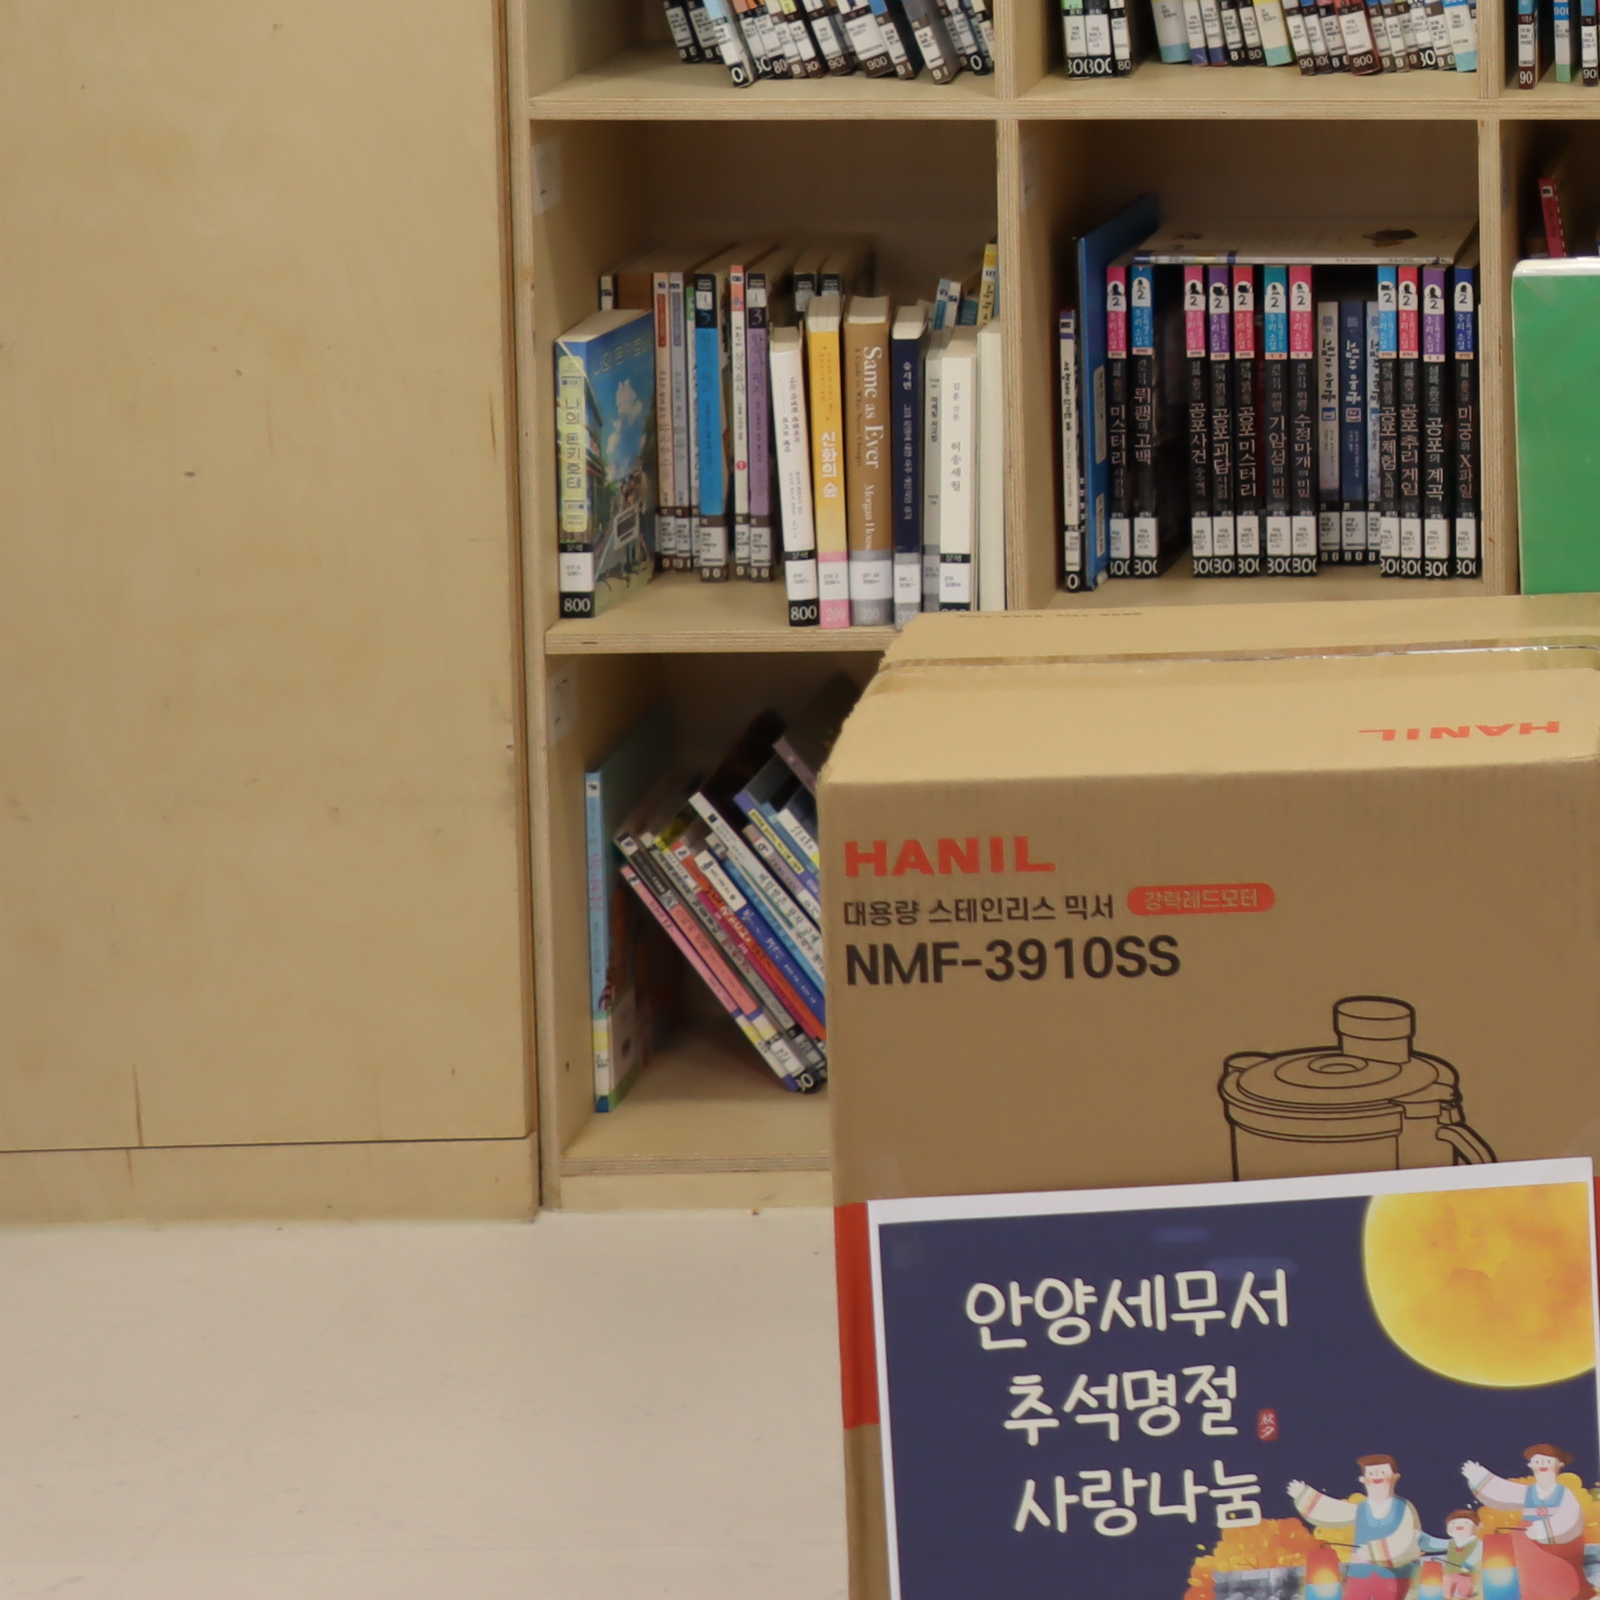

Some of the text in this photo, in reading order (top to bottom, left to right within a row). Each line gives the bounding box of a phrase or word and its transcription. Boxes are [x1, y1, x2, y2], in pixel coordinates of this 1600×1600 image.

[866, 55, 888, 70] 900
[1353, 54, 1373, 68] 900
[863, 346, 884, 470] Same as Ever
[1425, 416, 1444, 501] 공포의 계곡
[563, 598, 591, 613] 800
[790, 605, 817, 621] 800
[1358, 720, 1561, 742] HANIL
[844, 835, 1056, 878] HANIL
[843, 899, 920, 927] 대용량
[928, 895, 1057, 925] 스테인리스
[1064, 893, 1115, 920] 믹서
[845, 934, 1182, 987] NMF-3910SS
[964, 1268, 1290, 1351] 안양세무서
[1003, 1364, 1239, 1447] 추석명절
[1013, 1459, 1264, 1537] 사랑나눔
